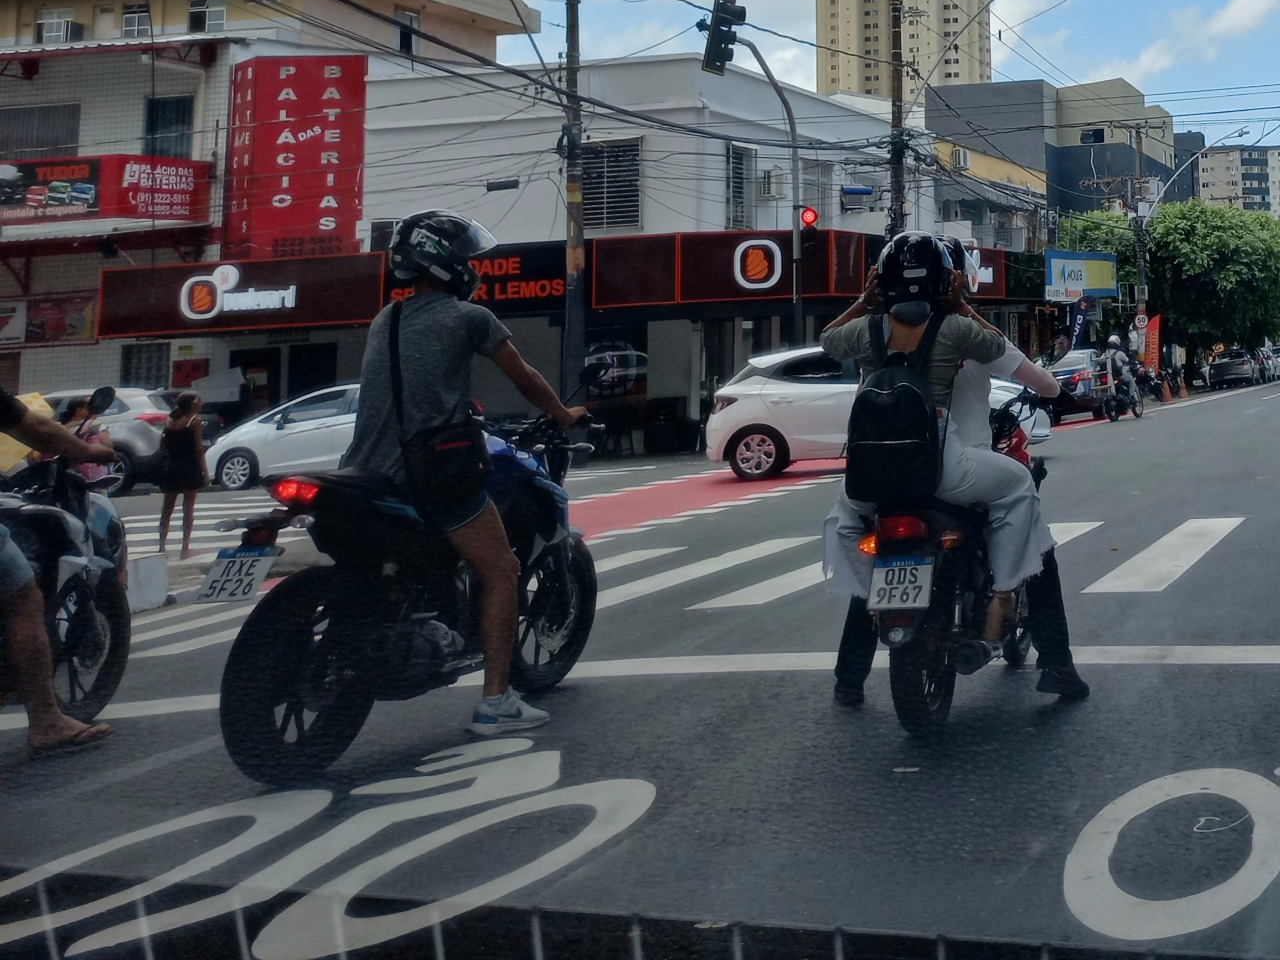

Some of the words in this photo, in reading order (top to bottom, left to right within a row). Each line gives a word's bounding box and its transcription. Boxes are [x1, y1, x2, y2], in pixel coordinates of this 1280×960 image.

[272, 66, 297, 208] PALÁCIO
[298, 126, 322, 141] DAS
[319, 65, 343, 230] BATERIAS
[36, 164, 90, 181] TUDOR
[178, 167, 194, 176] DAS
[140, 174, 194, 190] BATERIAS
[137, 192, 152, 204] (91)
[153, 193, 190, 204] 3222-5815
[3, 206, 35, 217] instala
[494, 279, 565, 300] LEMOS
[1137, 316, 1147, 324] 50
[220, 558, 261, 578] RXE
[884, 567, 919, 586] QDS
[206, 577, 256, 598] 5F26
[876, 585, 924, 605] 9F67
